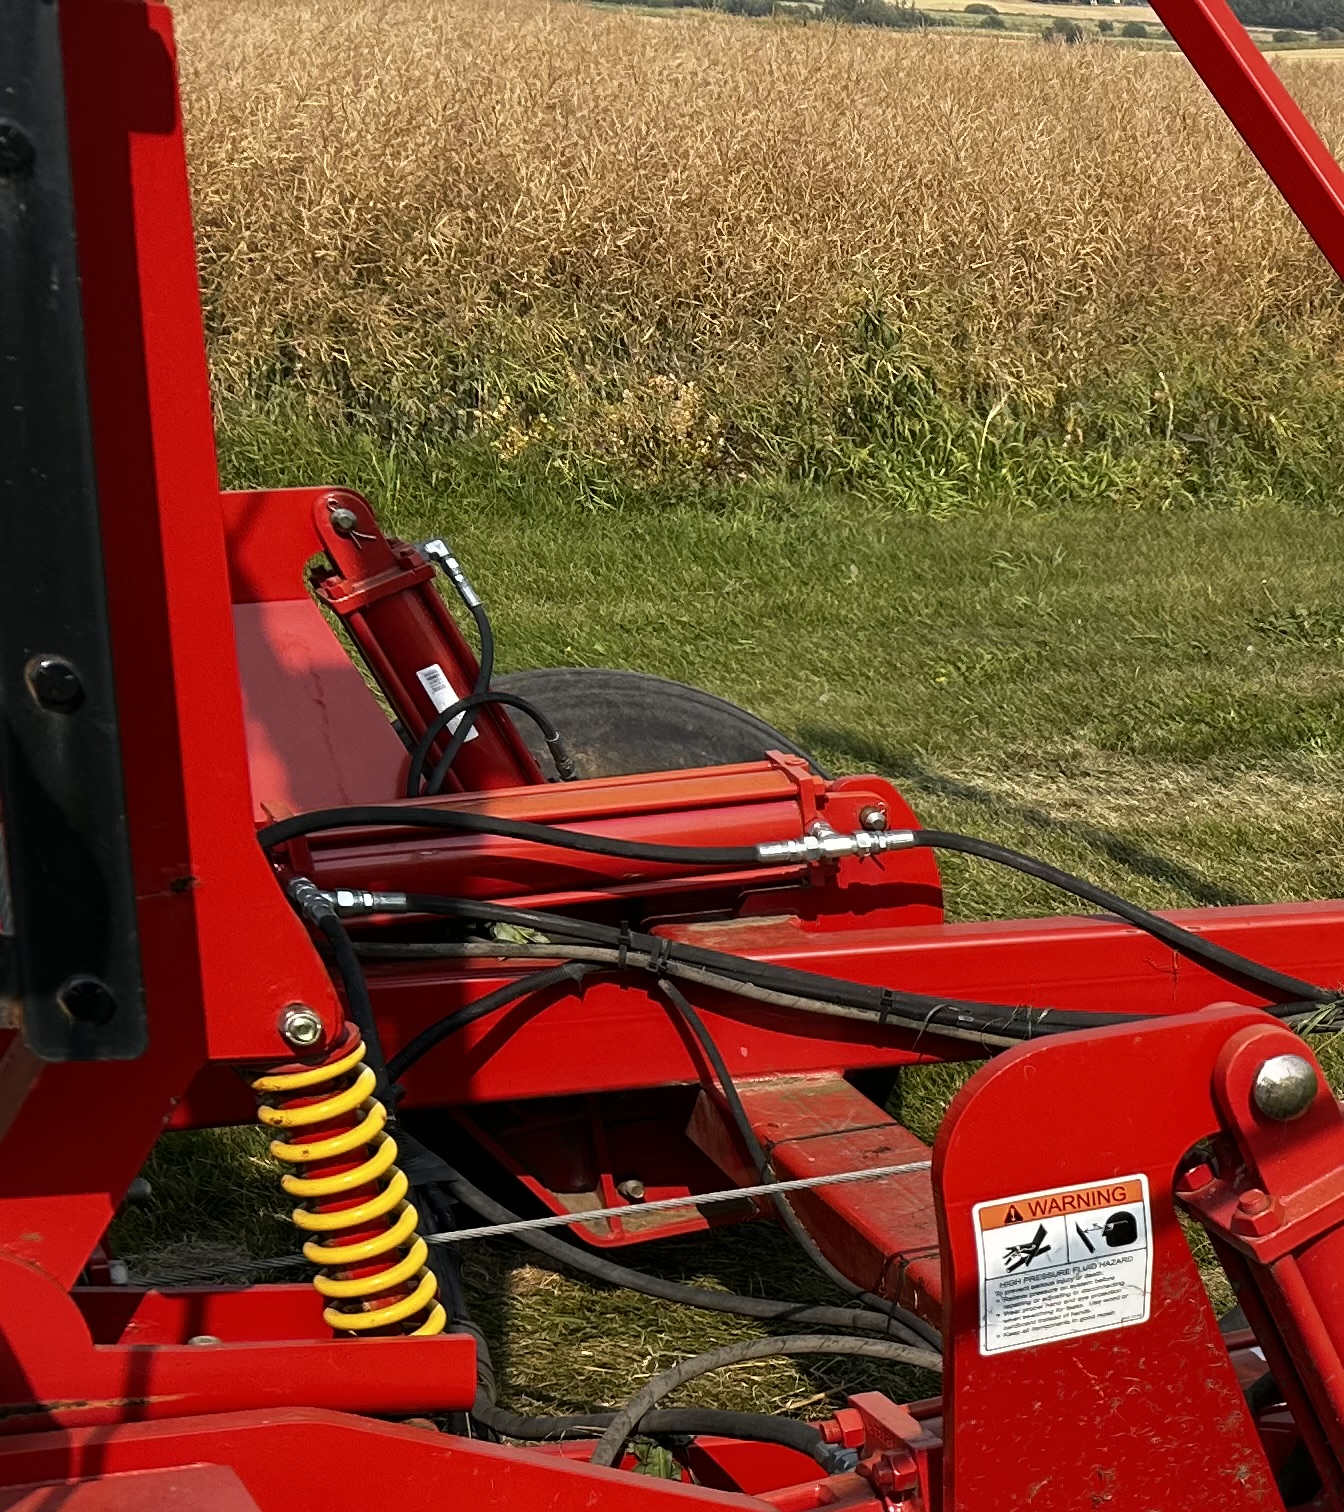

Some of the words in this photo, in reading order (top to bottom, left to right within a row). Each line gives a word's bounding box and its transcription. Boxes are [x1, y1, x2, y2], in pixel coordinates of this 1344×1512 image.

[1028, 1186, 1127, 1217] WARNING
[1023, 1268, 1070, 1283] PRESSURE
[1099, 1255, 1133, 1268] HAZARD
